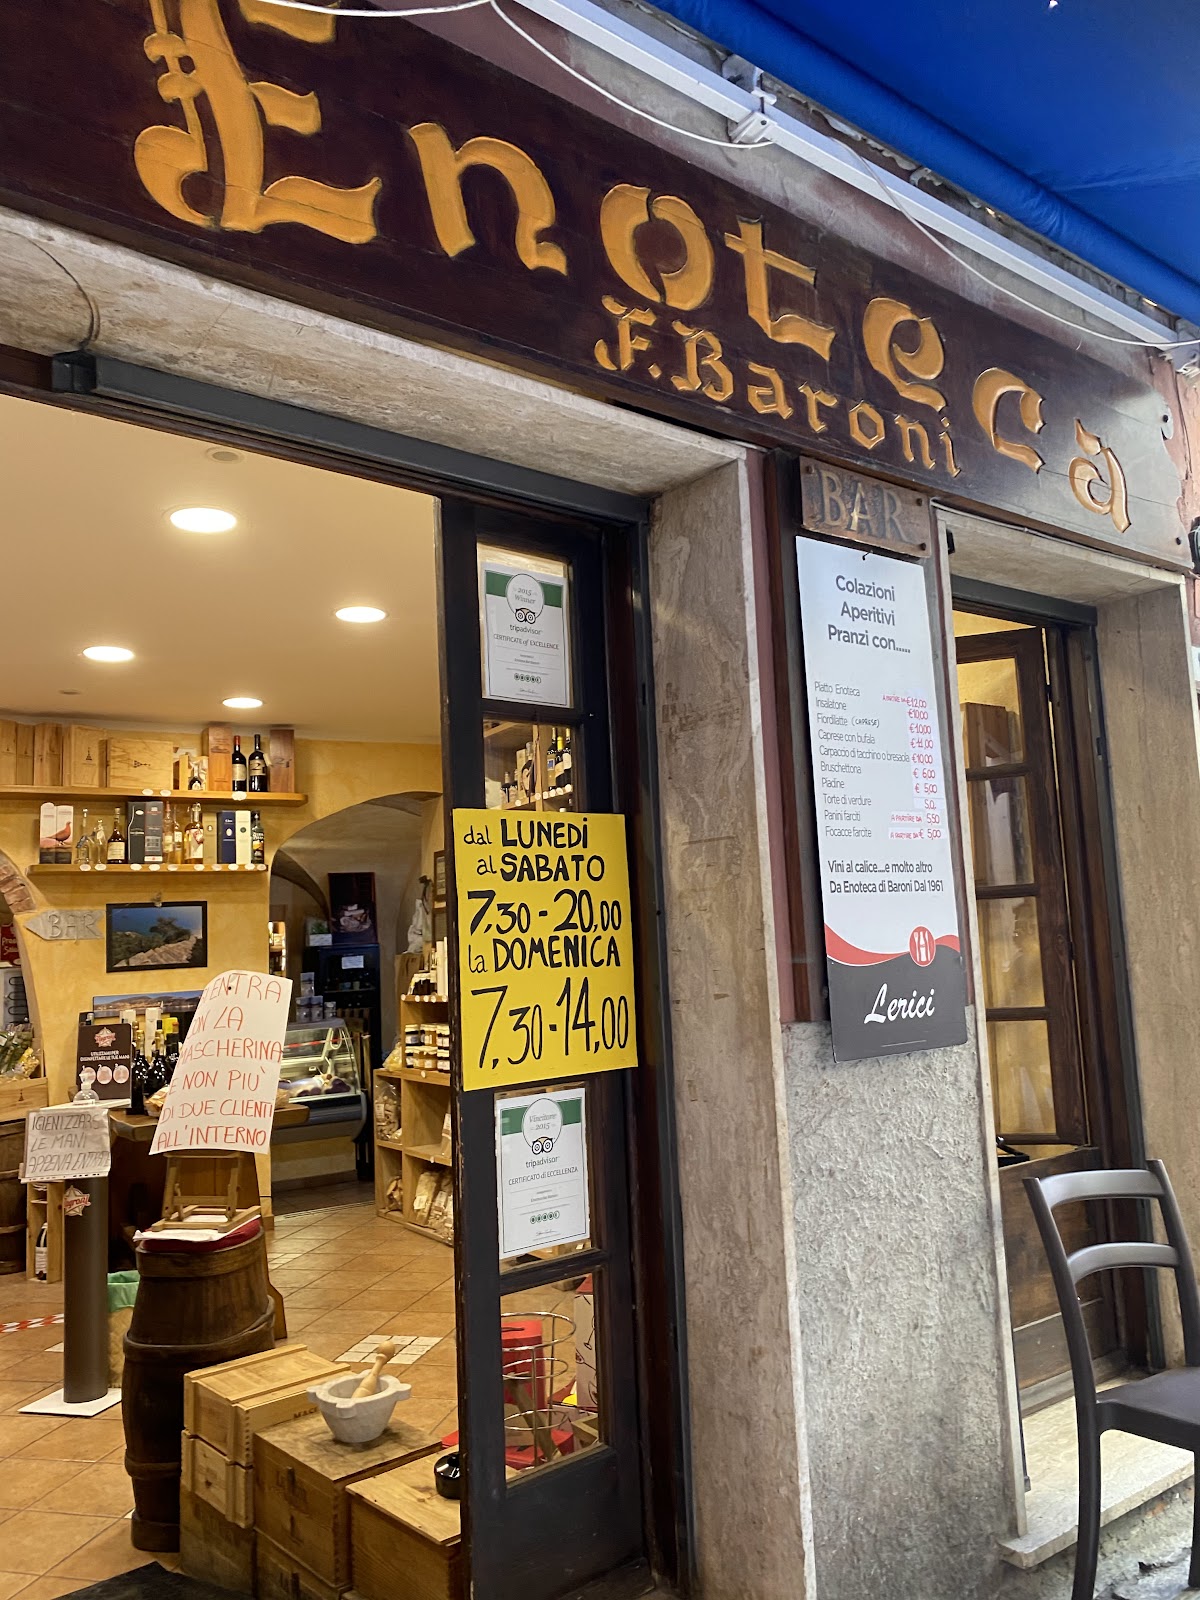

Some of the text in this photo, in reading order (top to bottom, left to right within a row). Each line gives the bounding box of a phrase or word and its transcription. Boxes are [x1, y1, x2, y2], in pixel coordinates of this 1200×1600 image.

[134, 0, 1131, 533] Enoteca
[817, 469, 914, 546] BAR
[517, 587, 532, 597] 2015
[835, 574, 896, 602] Colazioni
[514, 594, 537, 605] Winner
[840, 601, 896, 626] Aperitivi
[509, 624, 542, 636] tripadvisor
[827, 624, 869, 646] Pranzi
[493, 633, 523, 645] CERTIFICATE
[529, 639, 560, 651] EXCELLENCE
[814, 681, 861, 697] Piatto Enoteca
[815, 697, 847, 710] Insalatone
[816, 713, 848, 726] Fiordilatte
[818, 729, 876, 745] Caprese con bufala
[819, 745, 850, 759] Carpaccio
[851, 749, 856, 758] di
[856, 749, 881, 760] tacchino
[882, 752, 886, 761] o
[820, 761, 861, 775] Bruschettona
[821, 777, 845, 789] Piadine
[822, 793, 872, 806] Torte di verdure
[824, 809, 861, 822] Panini farciti
[463, 825, 493, 845] dal
[825, 825, 872, 839] Focacce farcite
[476, 853, 605, 882] al SABATO
[827, 860, 845, 873] Vini
[846, 860, 853, 873] al
[891, 860, 915, 873] molto
[915, 860, 933, 873] altro
[829, 879, 944, 894] Da Enoteca di Baroni Dal 1961
[48, 913, 101, 943] BAR
[468, 935, 621, 974] la DOMENICA
[209, 973, 282, 1003] ENTRA
[863, 982, 935, 1024] Lerici
[213, 1006, 244, 1032] LA
[180, 1037, 284, 1065] MASCHERINA
[182, 1070, 218, 1090] NON
[228, 1066, 266, 1092] PIÙ
[179, 1100, 216, 1119] DUE
[219, 1099, 273, 1119] CLIENTI
[529, 1113, 558, 1124] Vincitore
[535, 1122, 551, 1131] 2015
[30, 1132, 87, 1152] LE MANI
[157, 1124, 267, 1151] ALL'INTERNO
[525, 1156, 559, 1169] tripadvisor
[508, 1166, 579, 1186] CERTIFICATO di ECCELLENZA
